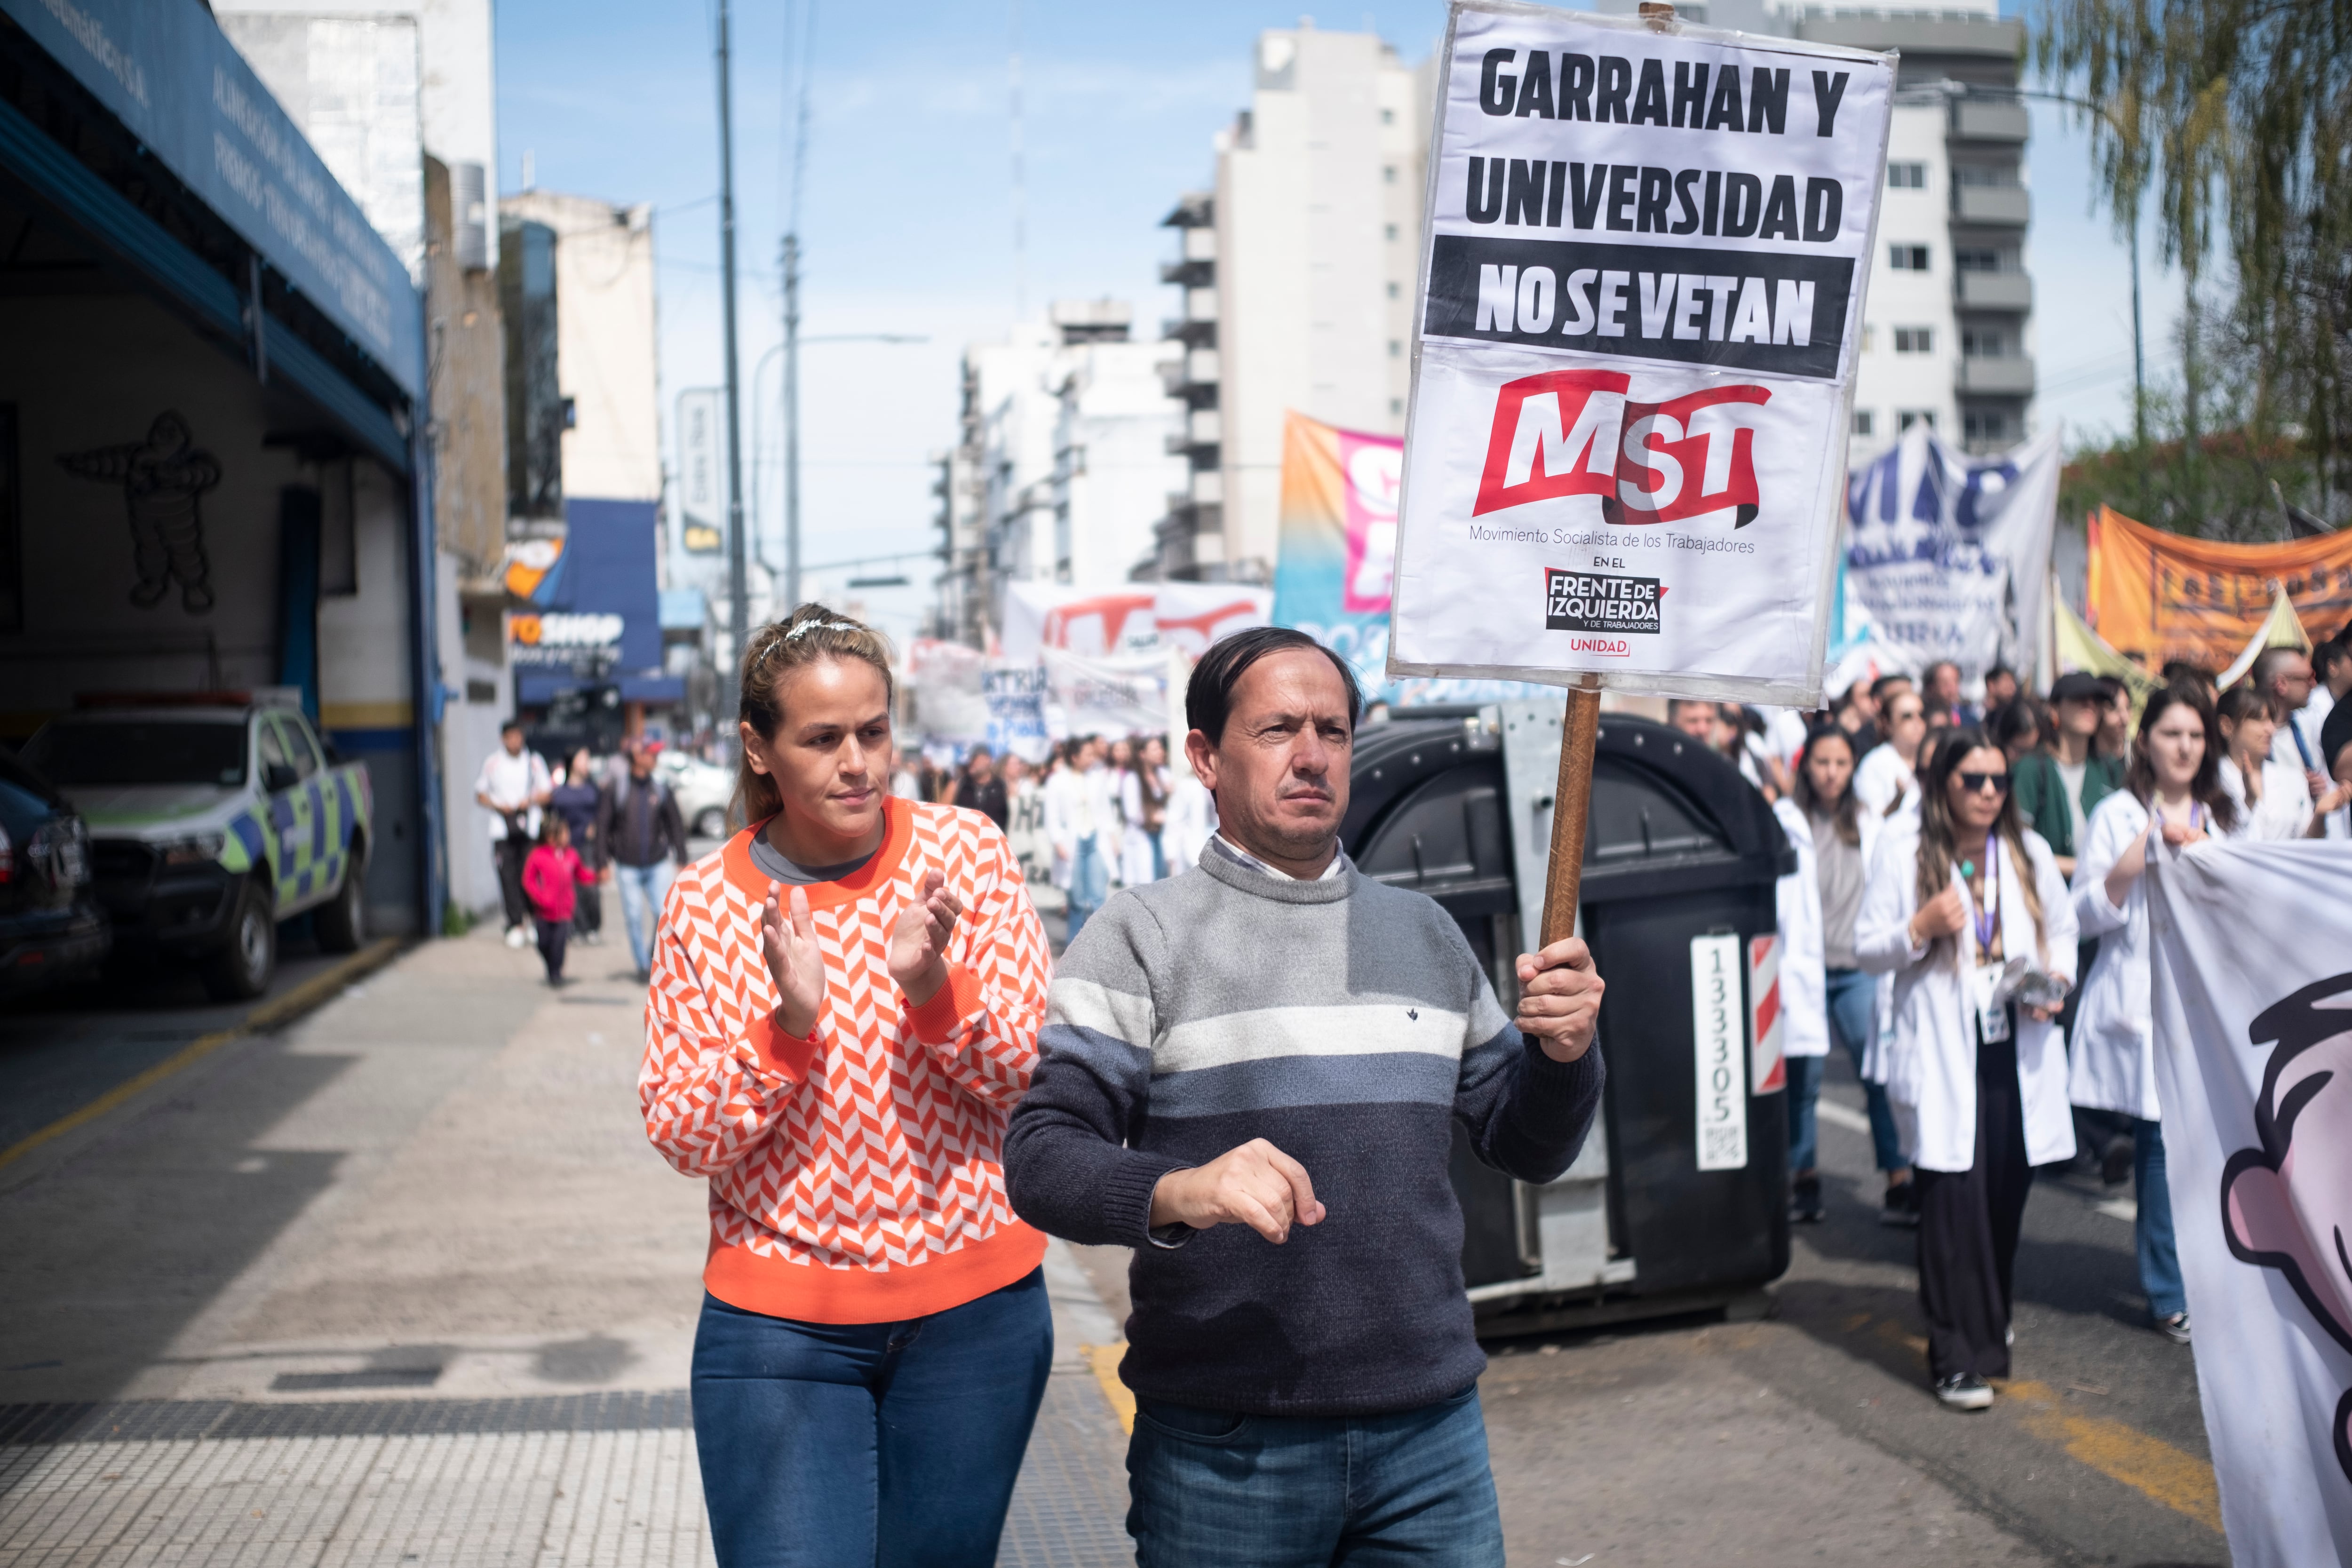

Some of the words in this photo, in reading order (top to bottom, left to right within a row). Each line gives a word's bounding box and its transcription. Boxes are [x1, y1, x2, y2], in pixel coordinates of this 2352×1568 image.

[1479, 48, 1790, 135] GARRAHAN
[1812, 70, 1850, 137] Y
[1465, 156, 1843, 243] UNIVERSIDAD
[1475, 264, 1557, 334] NO
[1561, 268, 1631, 337] SE
[1638, 271, 1816, 346] VETAN
[1502, 390, 1766, 511] MST
[1470, 525, 1549, 543] Movimiento
[1553, 529, 1618, 547] Socialista
[1622, 533, 1639, 547] de
[1644, 533, 1661, 548] los
[1666, 533, 1755, 555] Trabajadores
[1594, 557, 1609, 567] EN
[1612, 558, 1625, 568] EL
[1550, 576, 1633, 599] FRENTE
[1634, 585, 1655, 599] DE
[1548, 597, 1658, 620] IZQUIERDA
[1603, 621, 1659, 630] TRABAJADORES
[1571, 638, 1627, 653] UNIDAD
[1710, 948, 1731, 1122] 133305
